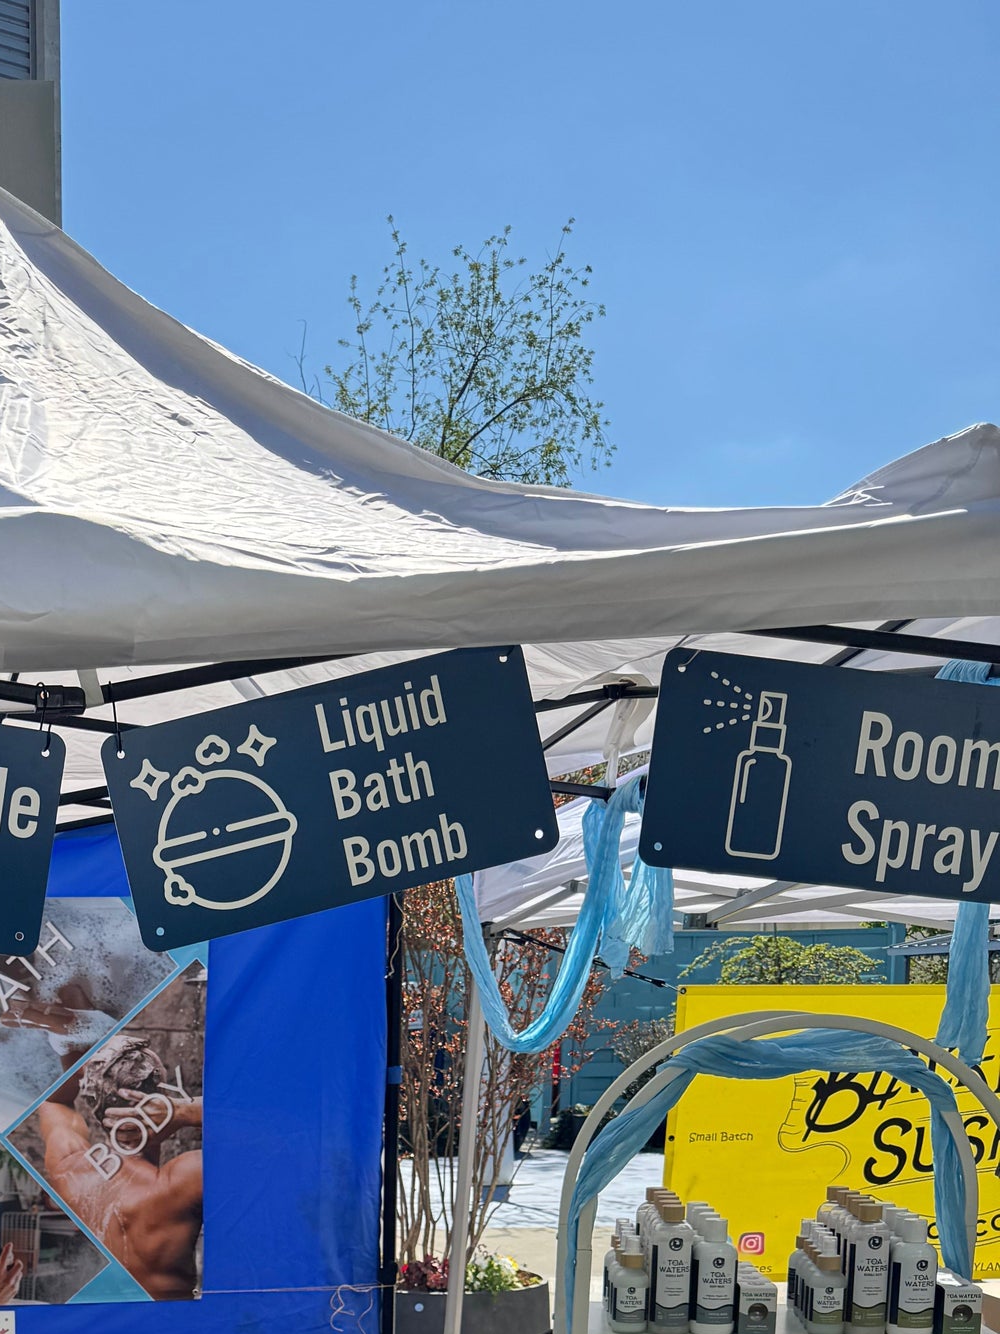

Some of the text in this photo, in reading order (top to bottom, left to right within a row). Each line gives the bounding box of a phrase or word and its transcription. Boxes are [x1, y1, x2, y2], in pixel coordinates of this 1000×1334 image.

[315, 676, 449, 757] Liquid
[854, 710, 1000, 791] Room
[329, 752, 434, 820] Bath
[342, 814, 469, 886] Bomb
[841, 800, 1000, 892] Spray
[84, 1066, 196, 1180] BODY
[689, 1131, 754, 1143] Small Batch
